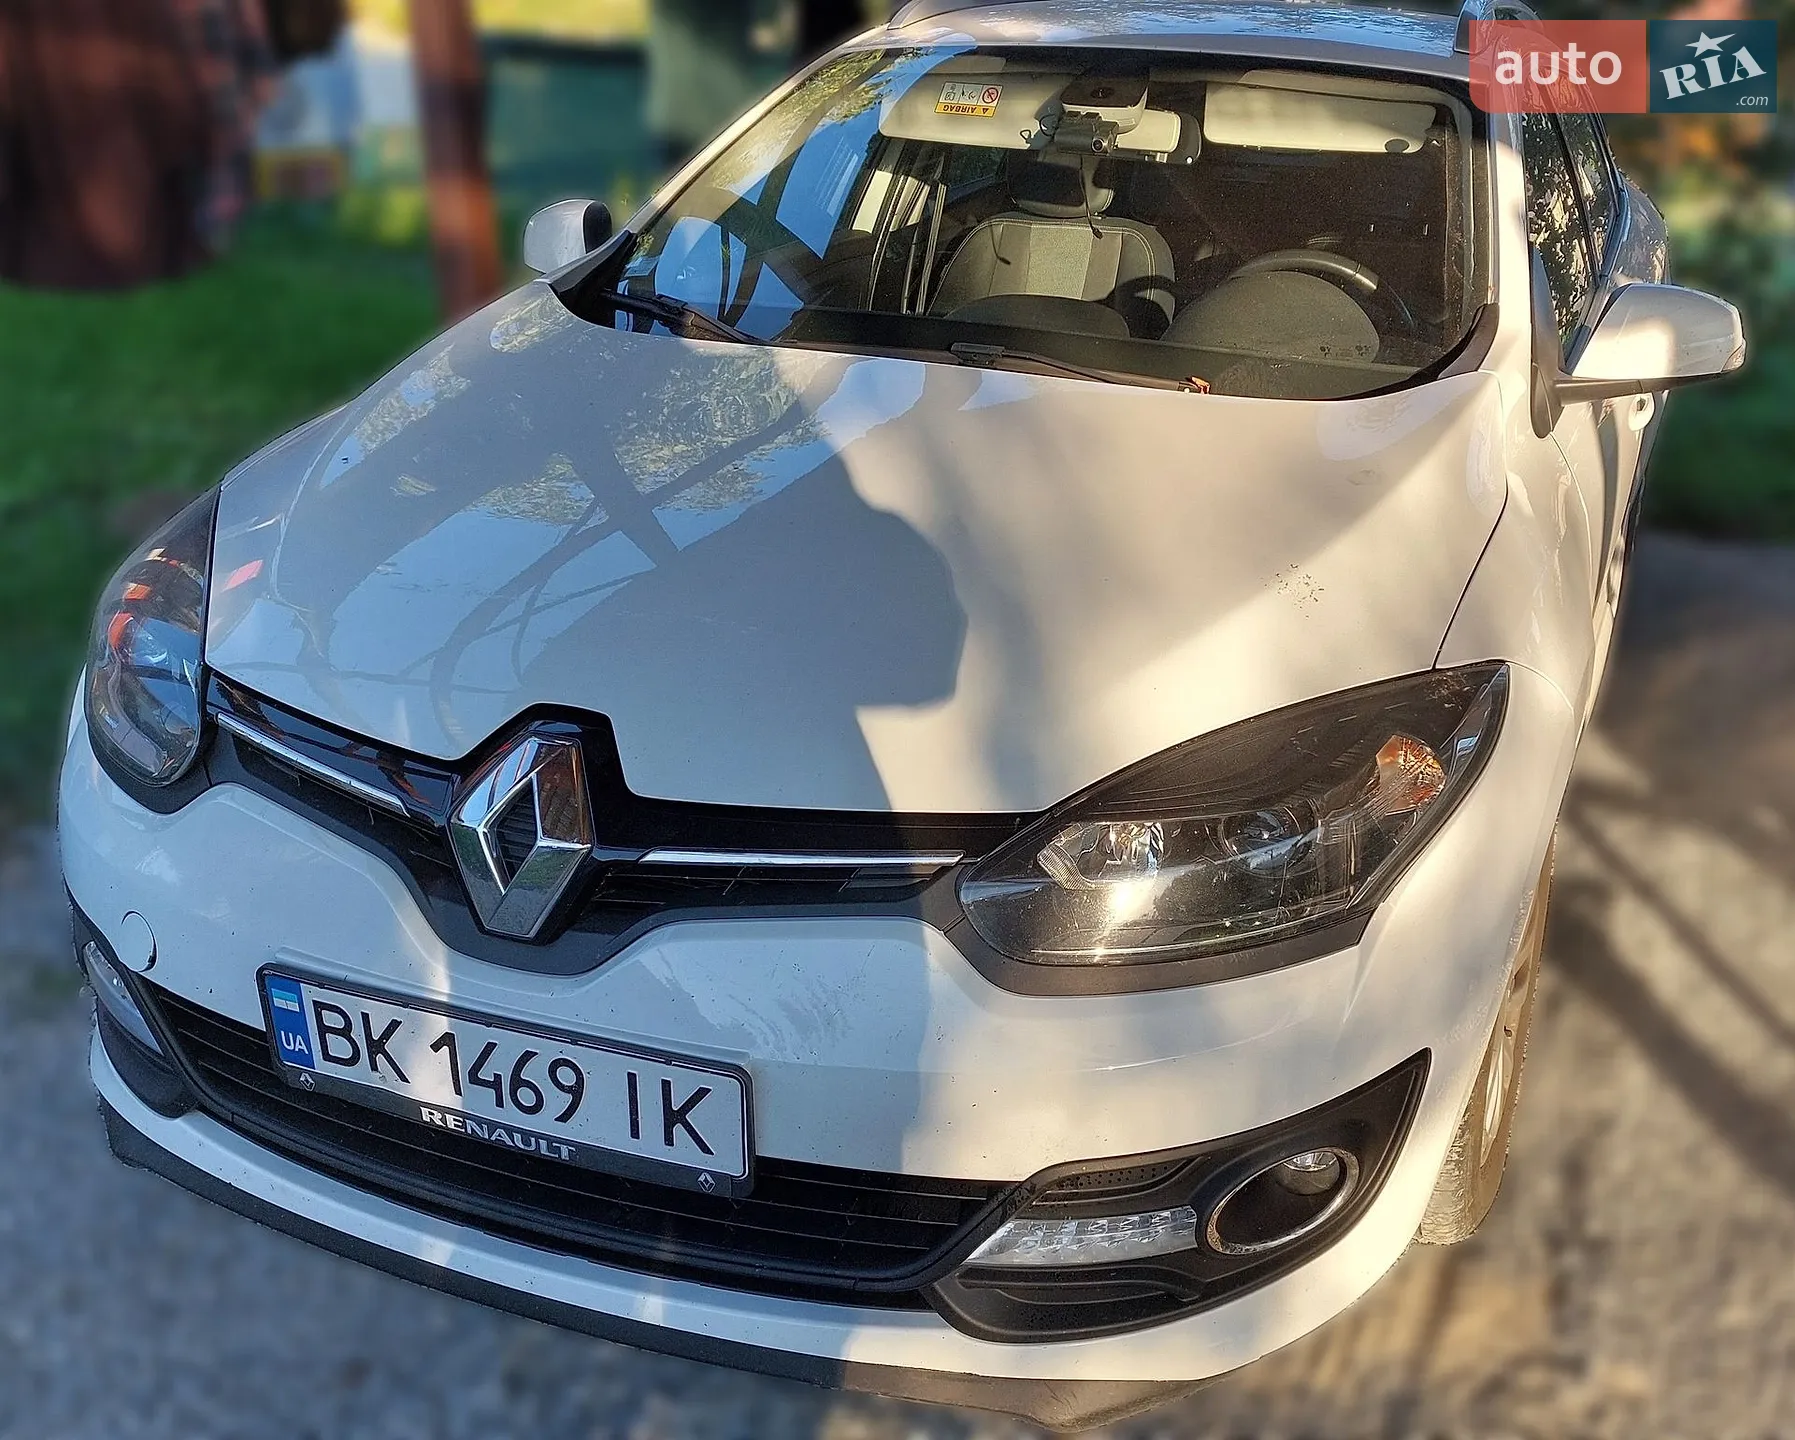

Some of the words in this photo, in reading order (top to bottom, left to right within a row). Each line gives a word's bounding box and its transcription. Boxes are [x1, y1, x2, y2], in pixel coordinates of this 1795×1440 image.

[942, 104, 977, 114] AIRBAG
[280, 1030, 309, 1055] UA
[312, 999, 411, 1084] BK
[430, 1032, 585, 1123] 1469
[627, 1071, 715, 1156] IK
[420, 1106, 576, 1160] RENAULT
